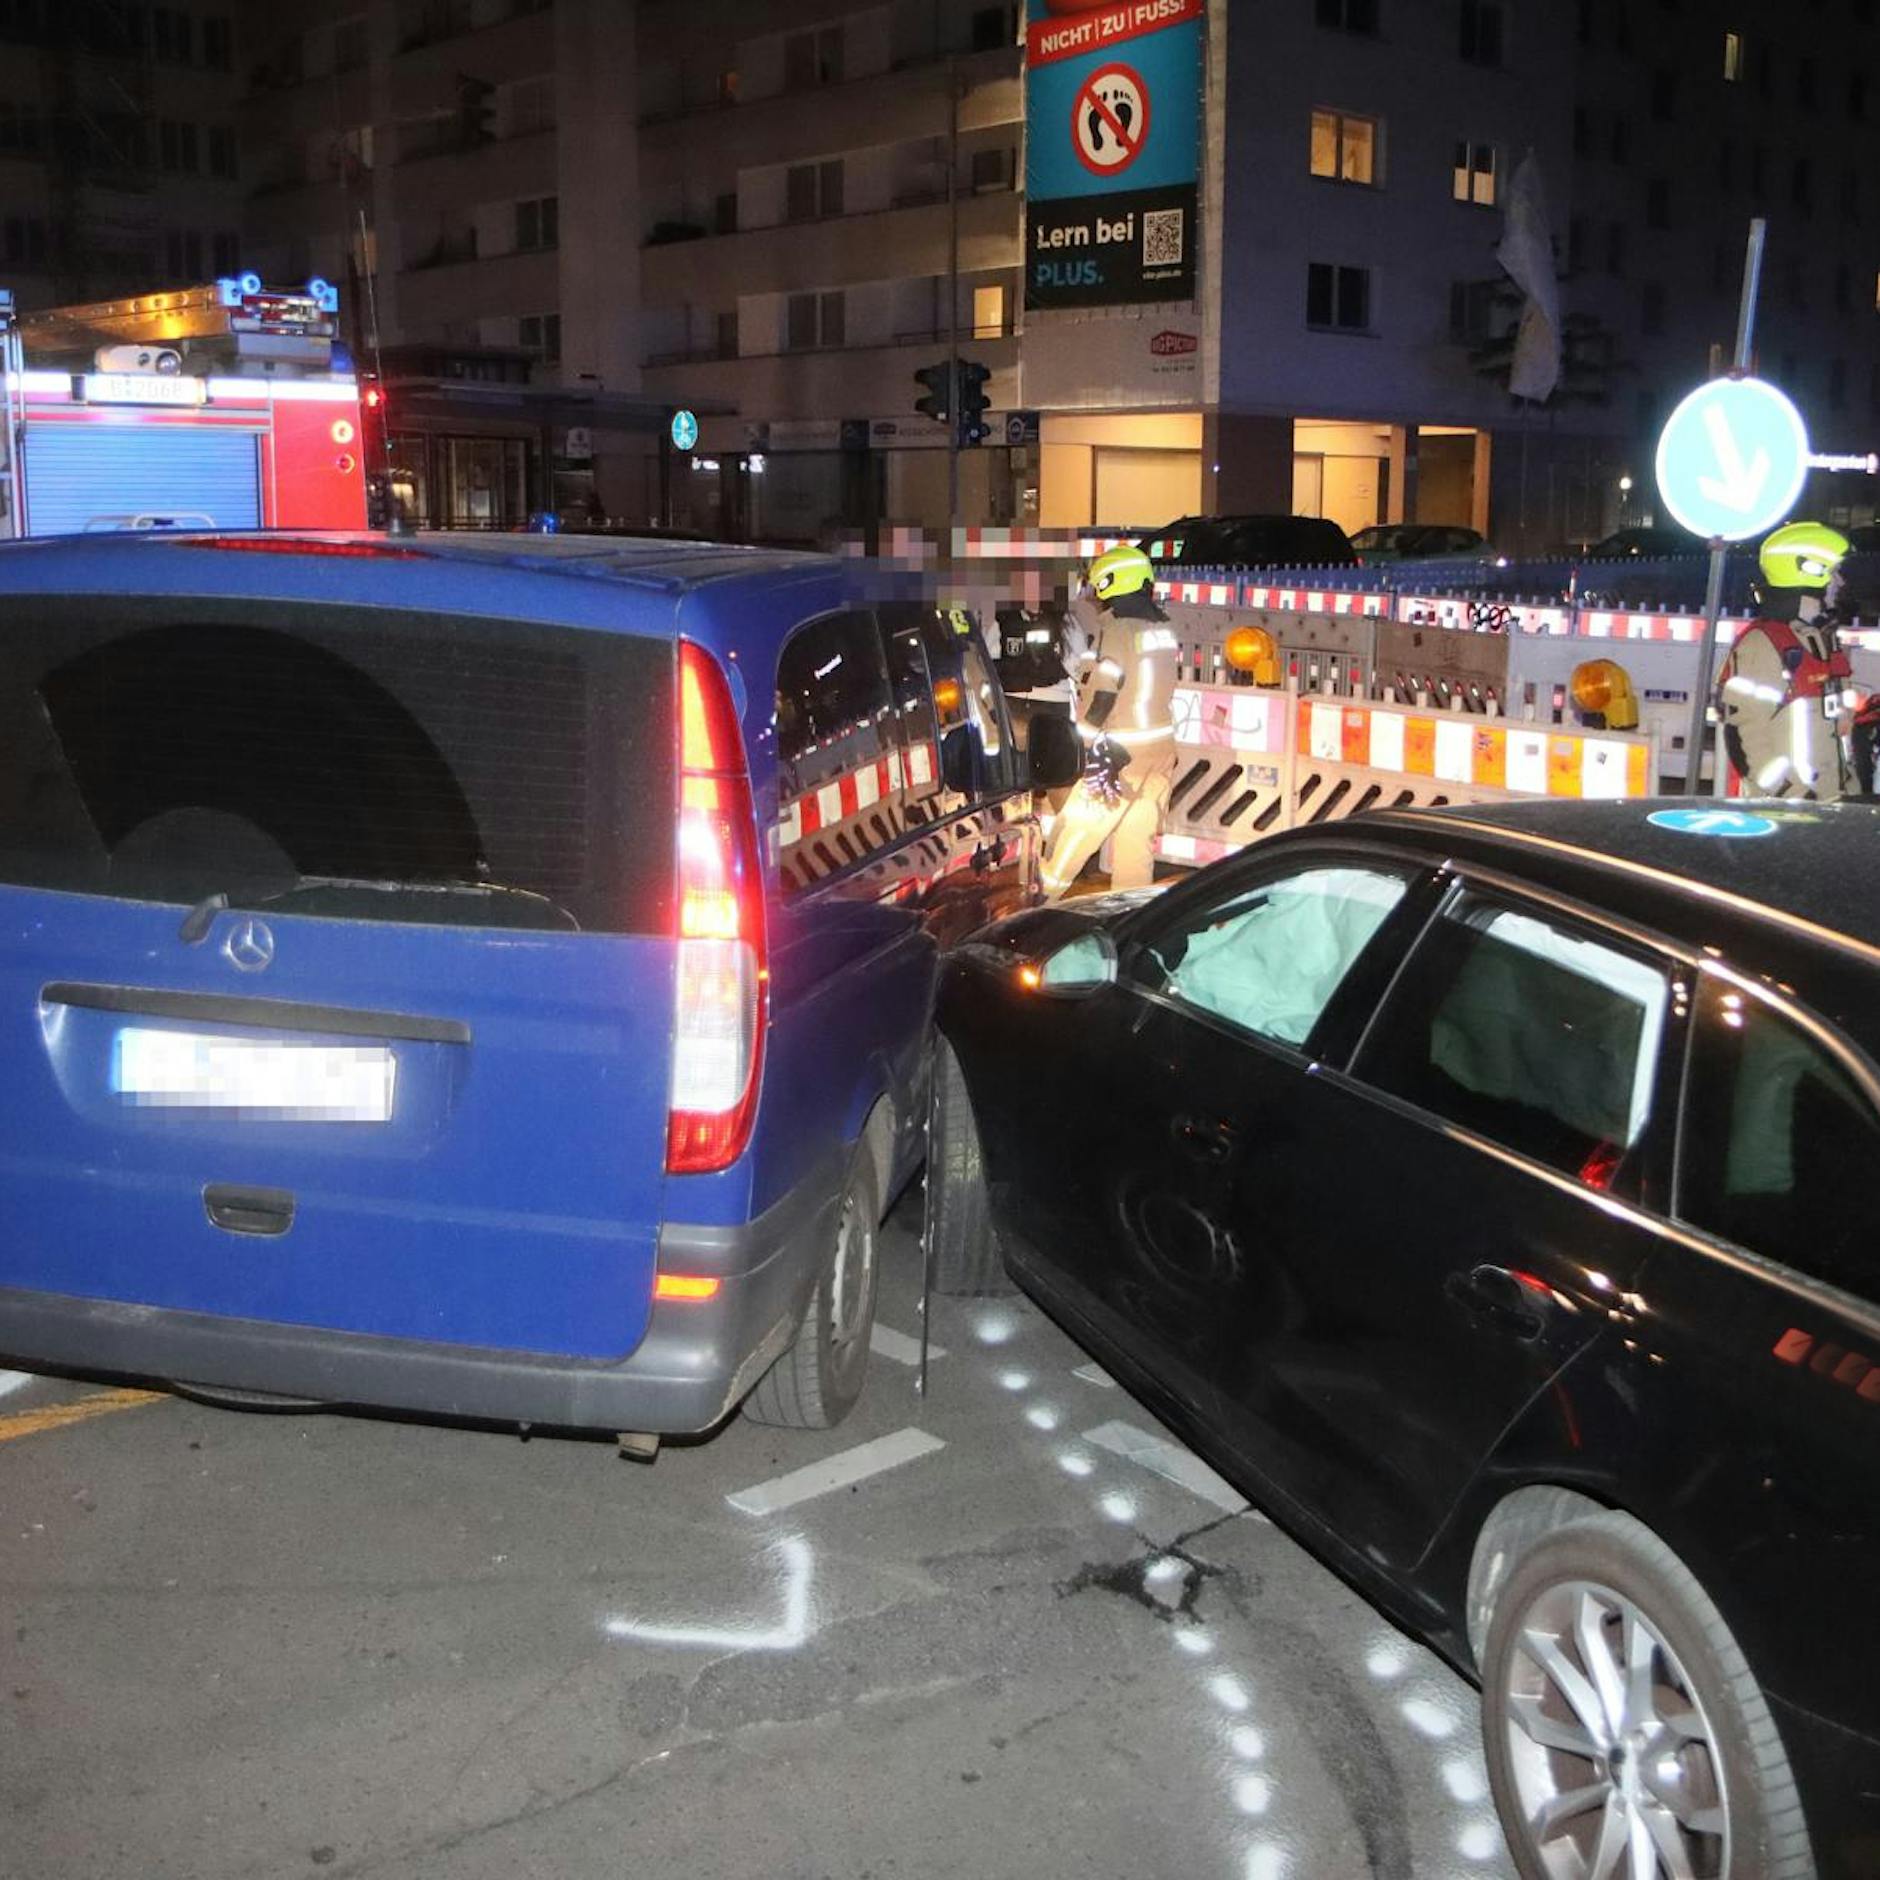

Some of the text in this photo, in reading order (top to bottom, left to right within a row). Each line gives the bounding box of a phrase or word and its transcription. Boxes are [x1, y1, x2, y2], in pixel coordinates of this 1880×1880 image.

[1041, 0, 1185, 54] NICHT ZU FUSS!
[1037, 212, 1134, 249] Lern bei
[1037, 260, 1104, 286] PLUS.
